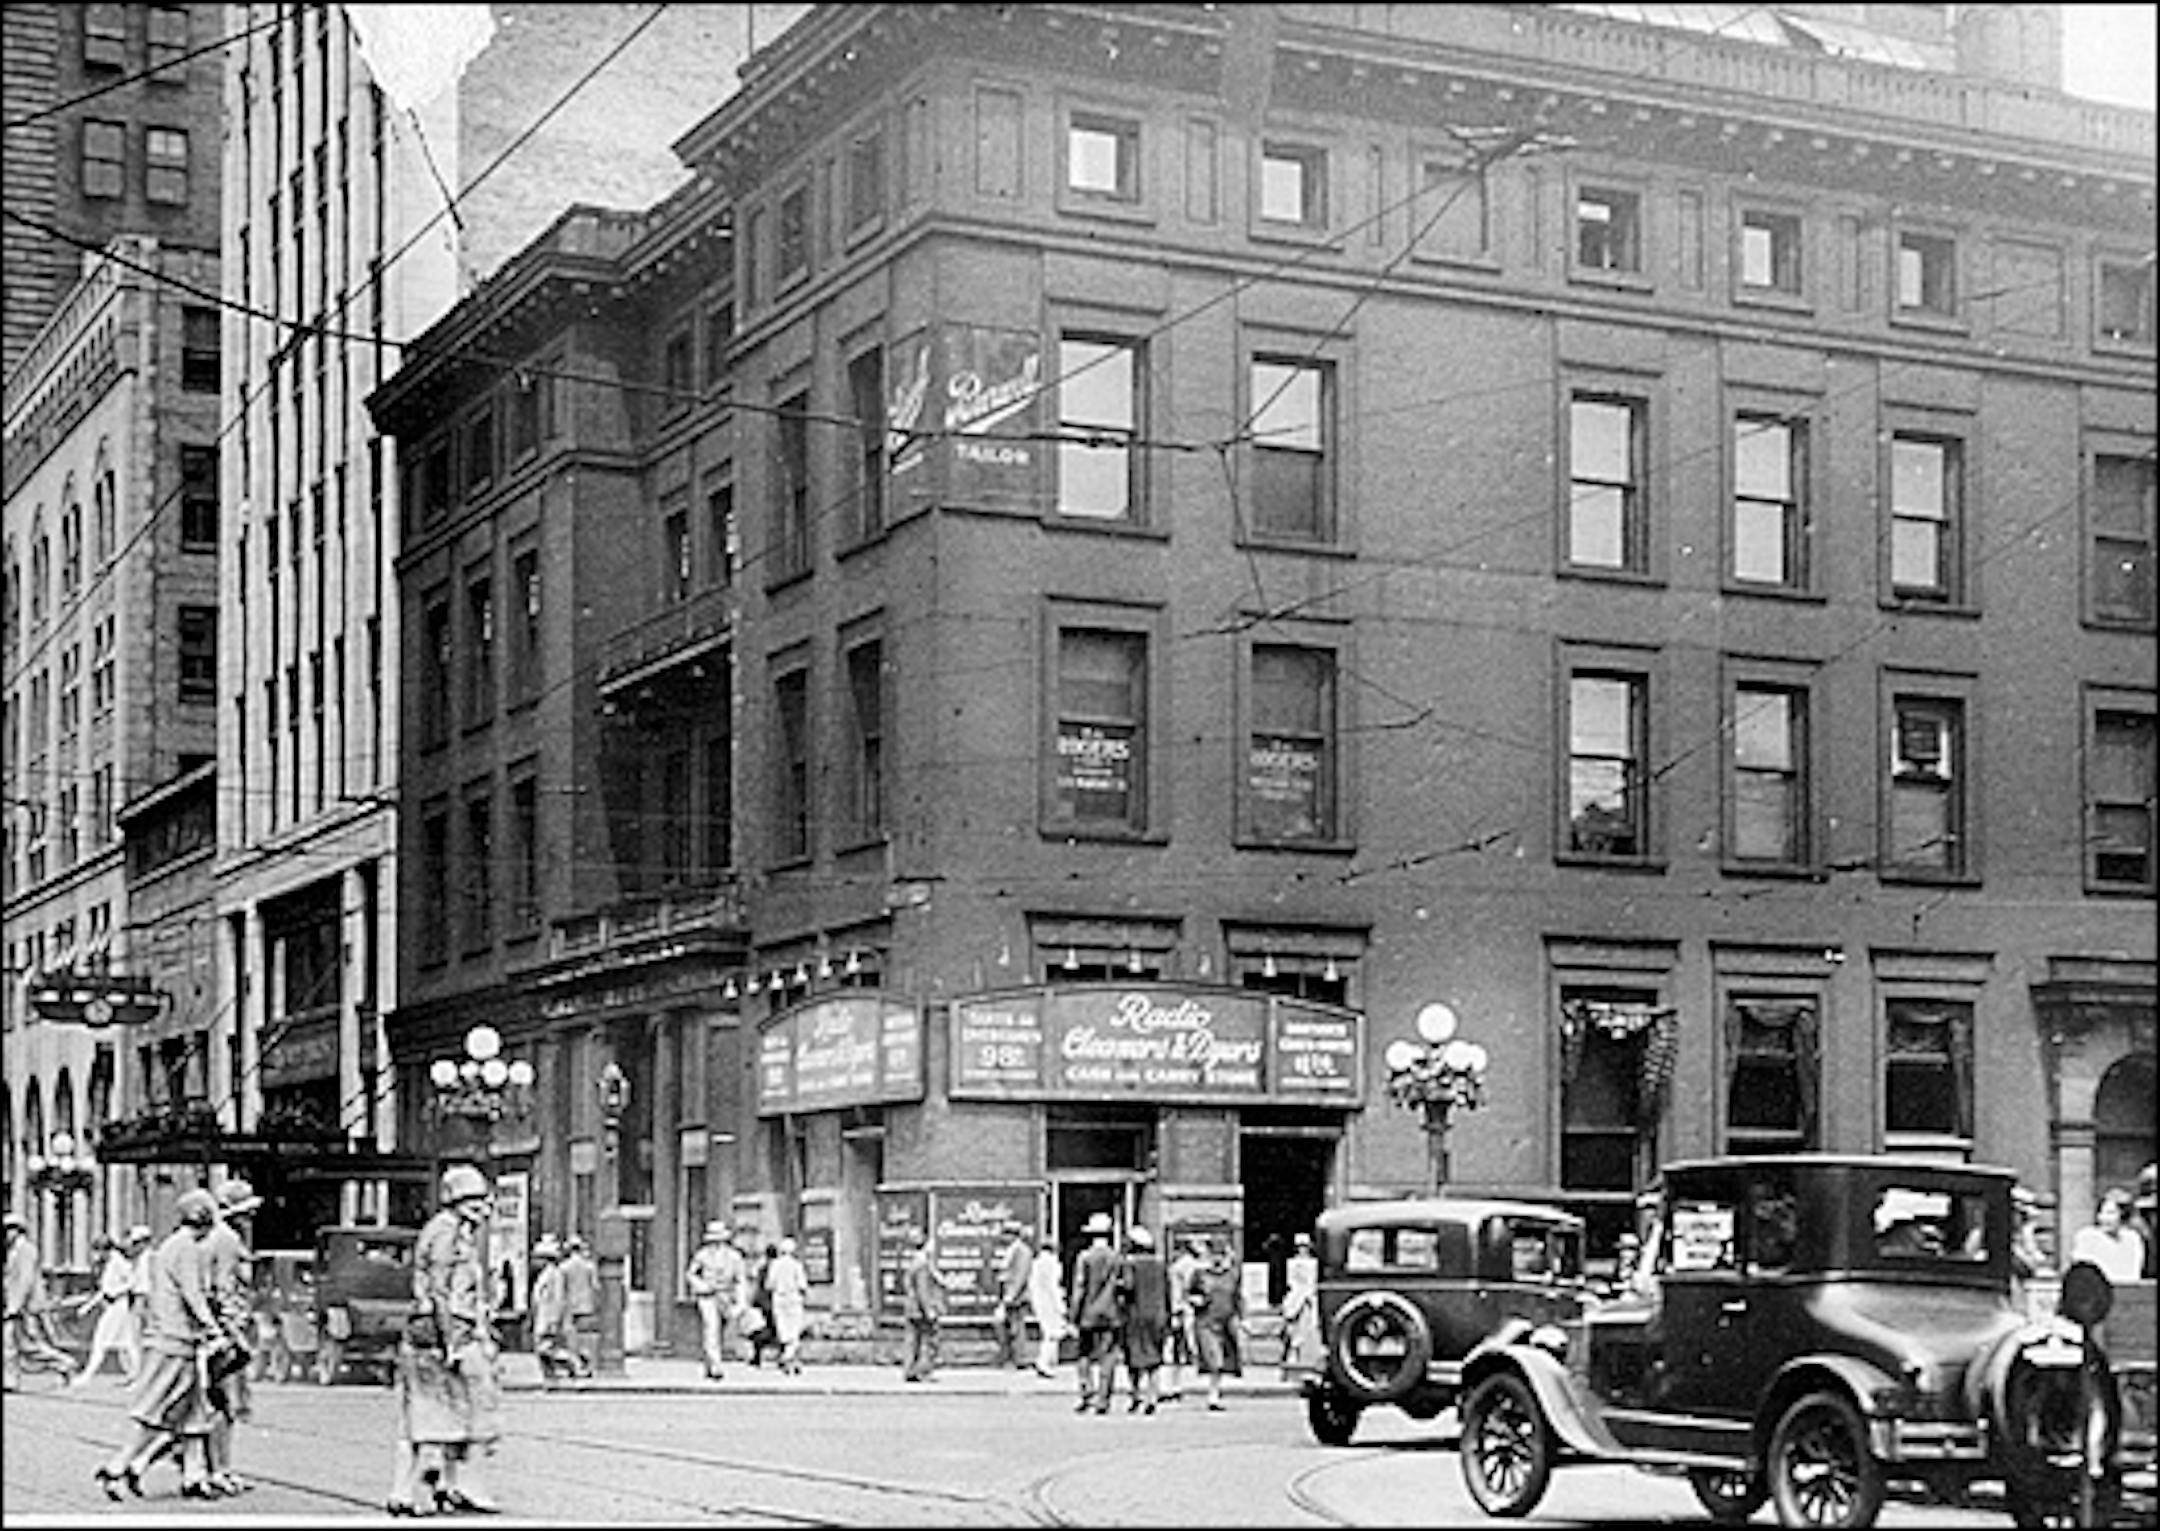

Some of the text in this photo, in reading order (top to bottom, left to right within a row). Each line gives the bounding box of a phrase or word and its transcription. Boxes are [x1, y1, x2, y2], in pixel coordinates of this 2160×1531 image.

[956, 444, 1029, 464] TAILOR
[1109, 993, 1212, 1033] Radio
[1063, 1026, 1169, 1060] Cleaners
[1187, 1028, 1263, 1072] Dyers
